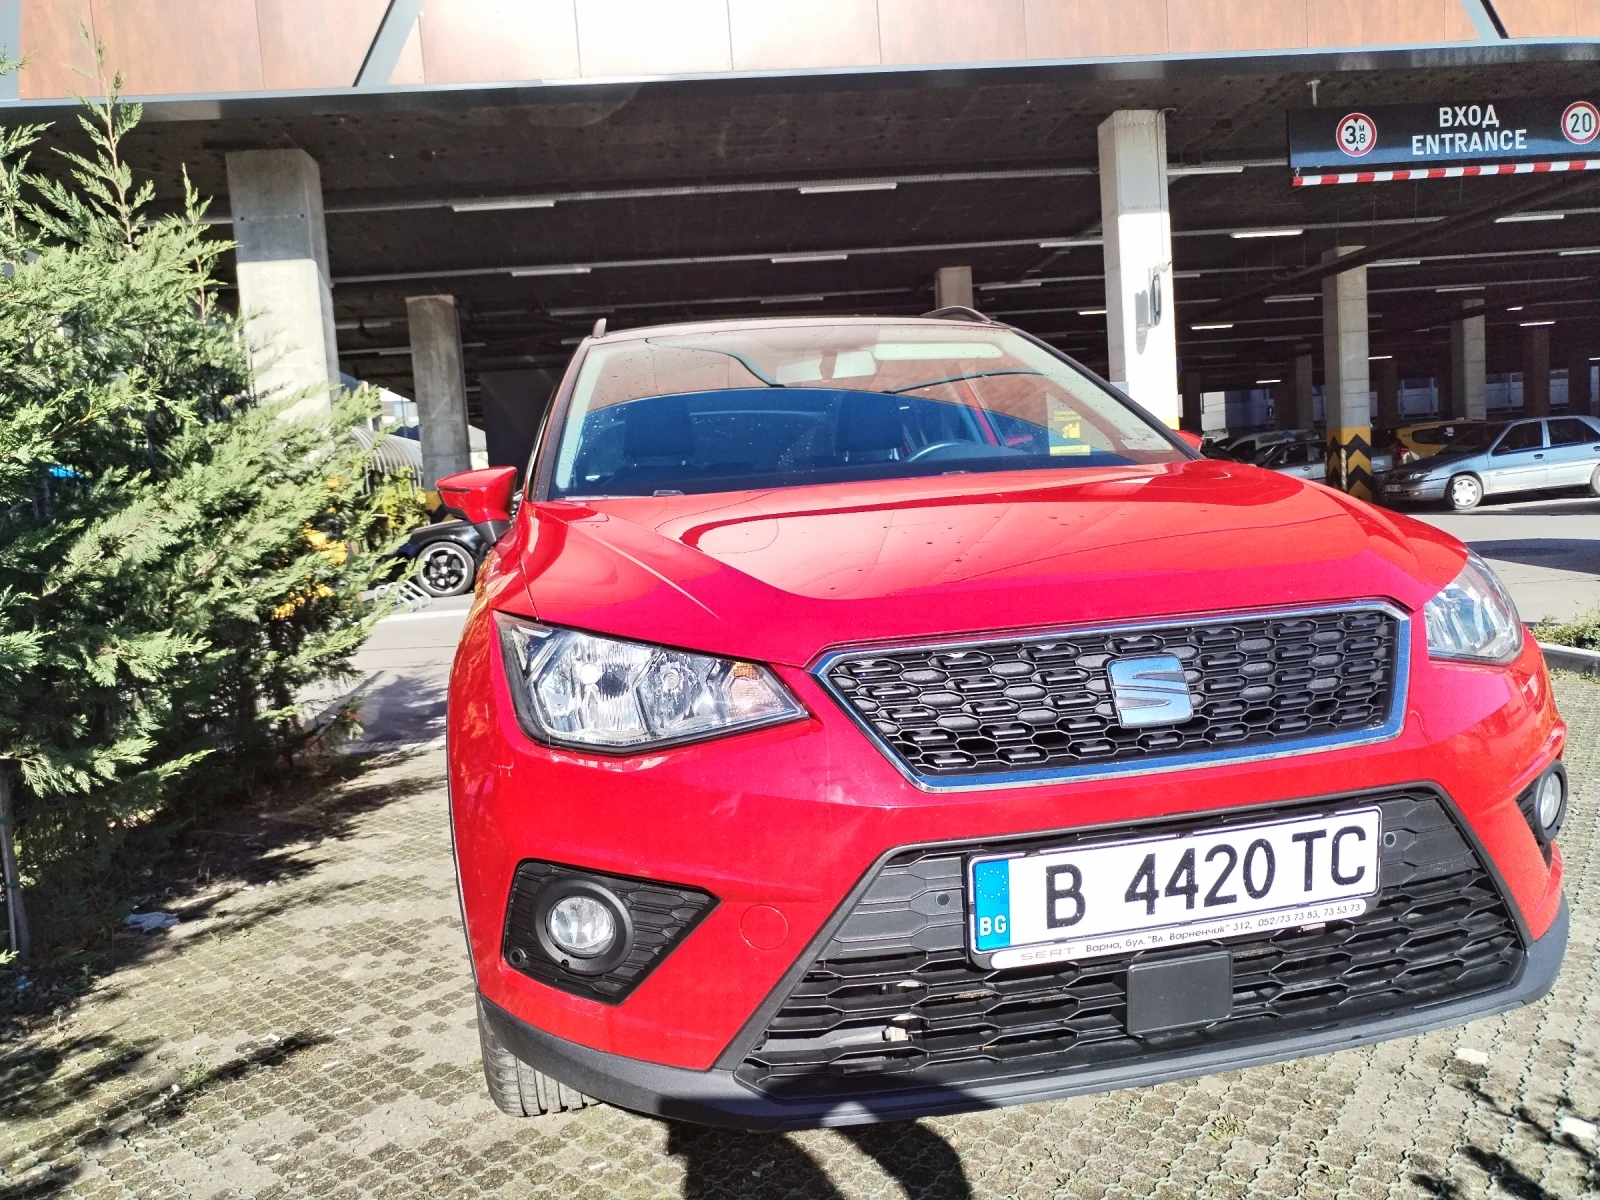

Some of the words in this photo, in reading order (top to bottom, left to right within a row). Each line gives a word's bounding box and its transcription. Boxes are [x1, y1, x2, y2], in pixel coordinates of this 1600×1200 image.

[1439, 104, 1500, 128] ВХОД
[1570, 112, 1592, 133] 20
[1411, 129, 1527, 156] ENTRANCE
[1045, 863, 1087, 930] B
[1124, 838, 1276, 916] 4420
[1291, 825, 1367, 892] TC
[979, 914, 1007, 937] BG
[1257, 914, 1291, 928] 052/73
[1293, 912, 1305, 922] 73
[1323, 907, 1335, 917] 73
[1336, 905, 1348, 915] 53
[1350, 903, 1361, 912] 73
[1020, 947, 1075, 961] SEAT
